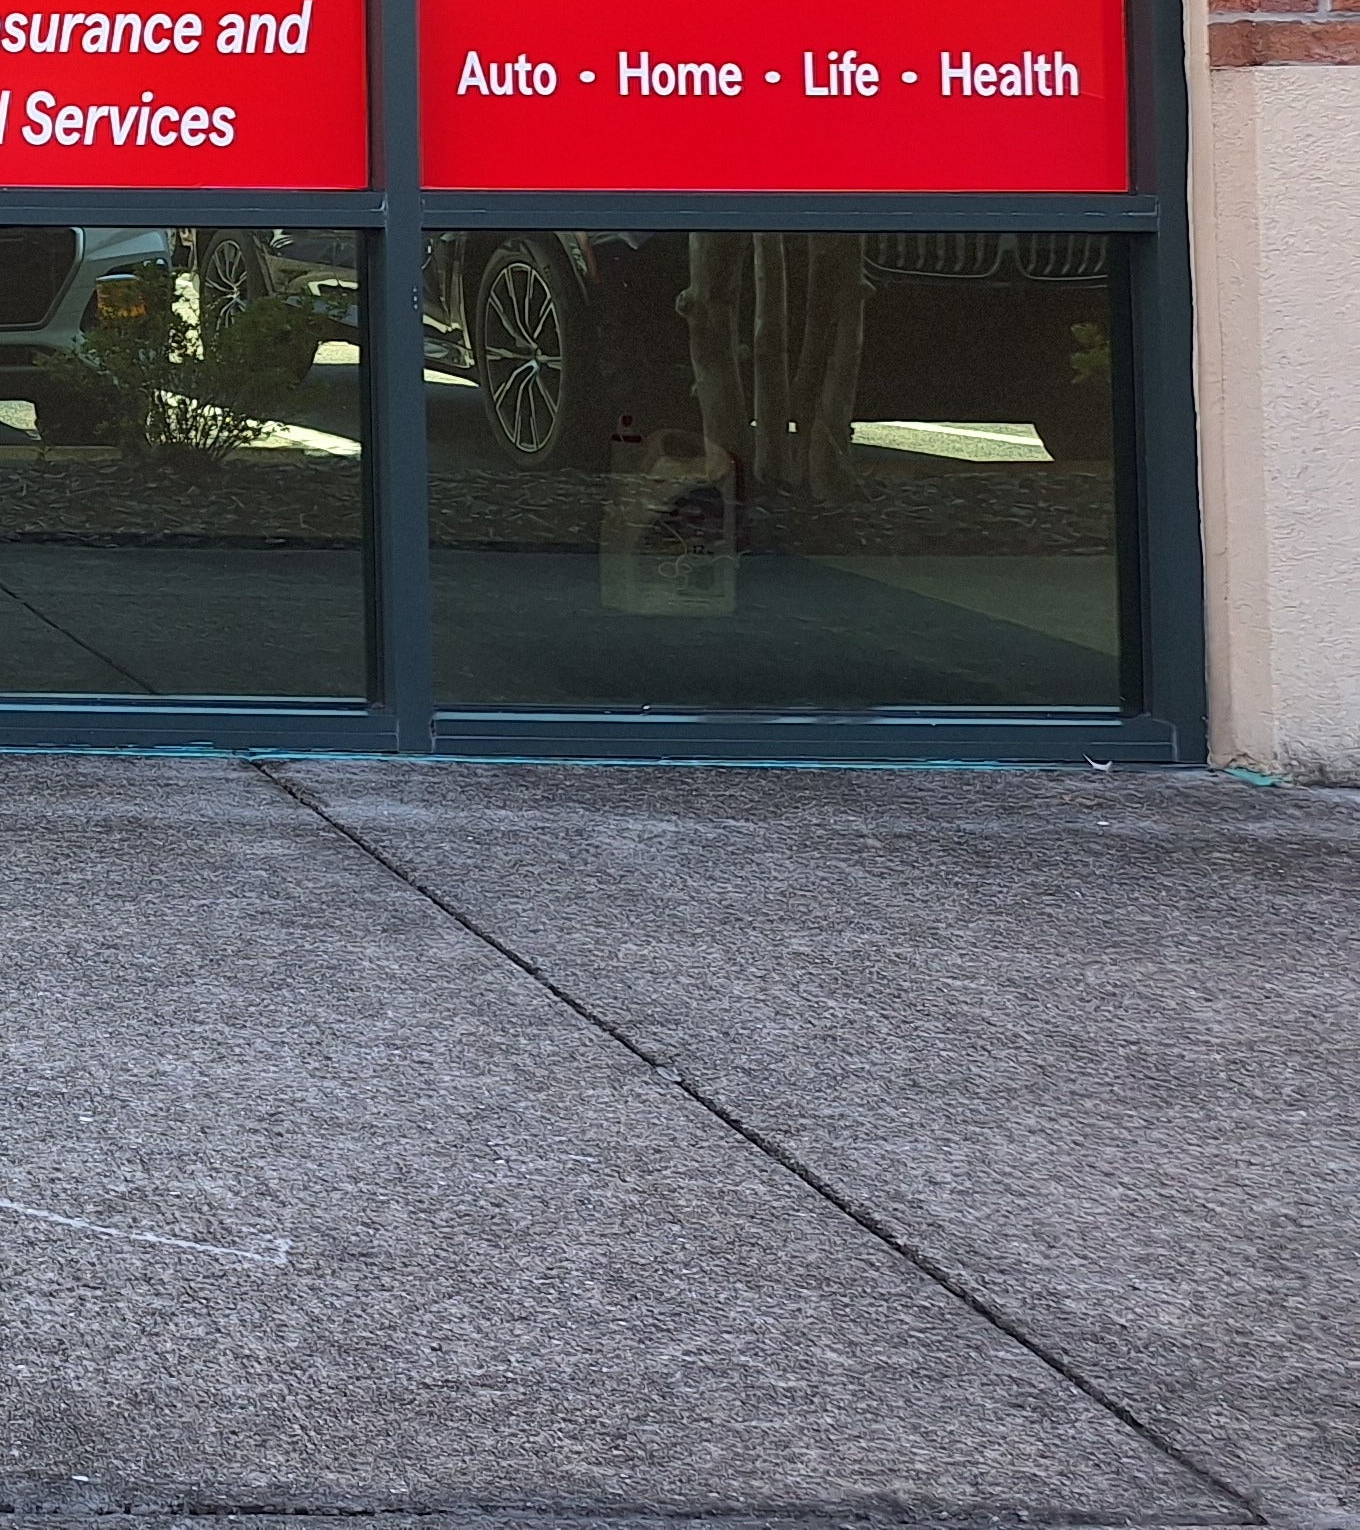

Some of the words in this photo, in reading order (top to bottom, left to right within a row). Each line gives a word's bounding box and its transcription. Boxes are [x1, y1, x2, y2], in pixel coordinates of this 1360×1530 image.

[217, 0, 312, 53] and
[458, 51, 556, 95] Auto
[619, 52, 742, 95] Home
[805, 50, 879, 96] Life
[941, 51, 1078, 96] Health
[22, 91, 235, 146] Services
